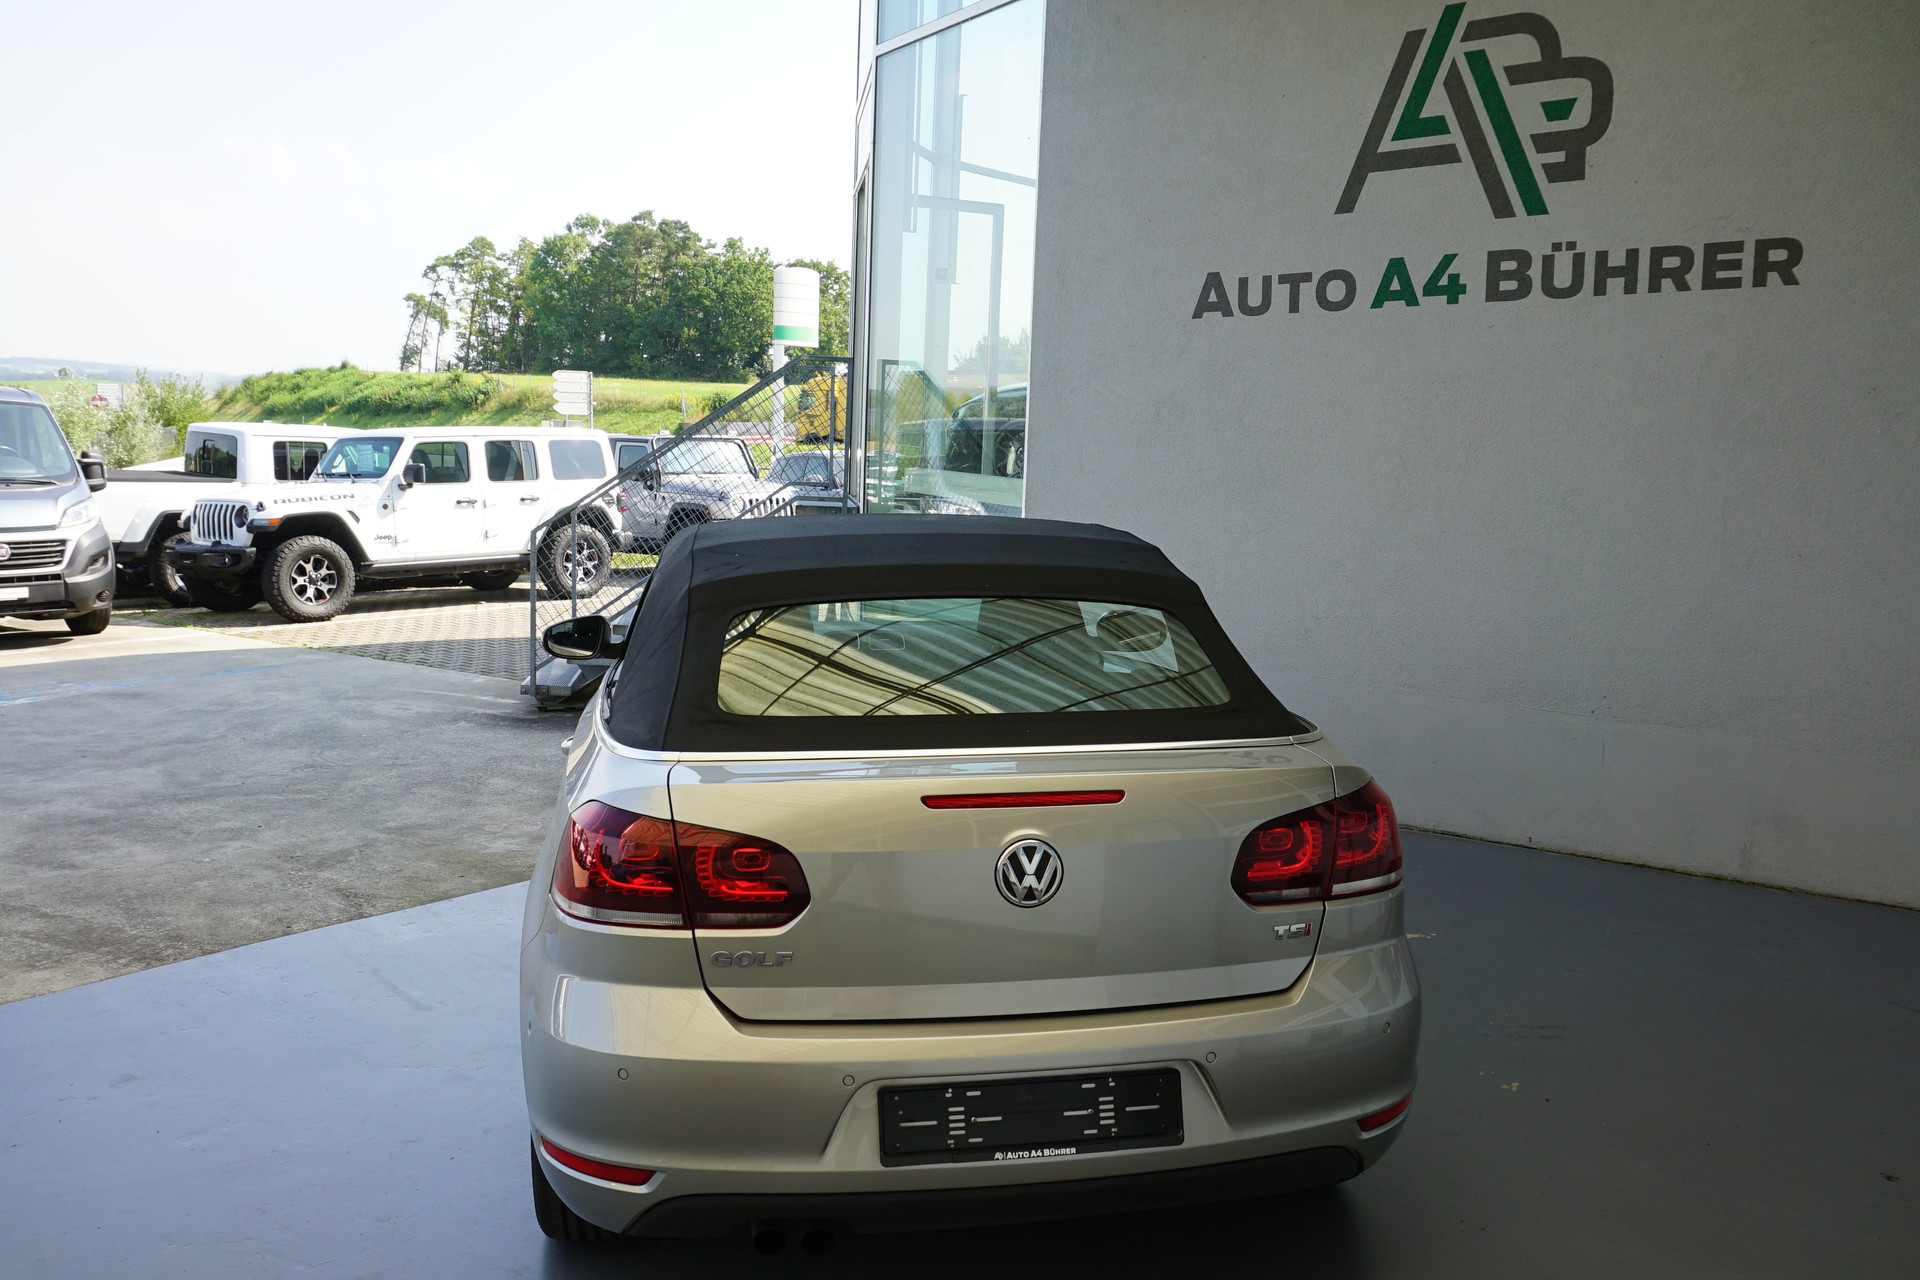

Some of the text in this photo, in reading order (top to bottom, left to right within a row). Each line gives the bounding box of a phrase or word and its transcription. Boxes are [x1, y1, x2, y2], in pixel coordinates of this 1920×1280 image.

[1191, 236, 1804, 319] AUTO A4 BÜHRER
[273, 494, 355, 504] RUBICON
[999, 842, 1060, 903] VW
[1273, 922, 1313, 940] TSI
[710, 950, 794, 968] GOLF
[1006, 1151, 1029, 1159] AUTO
[1030, 1149, 1042, 1158] A4
